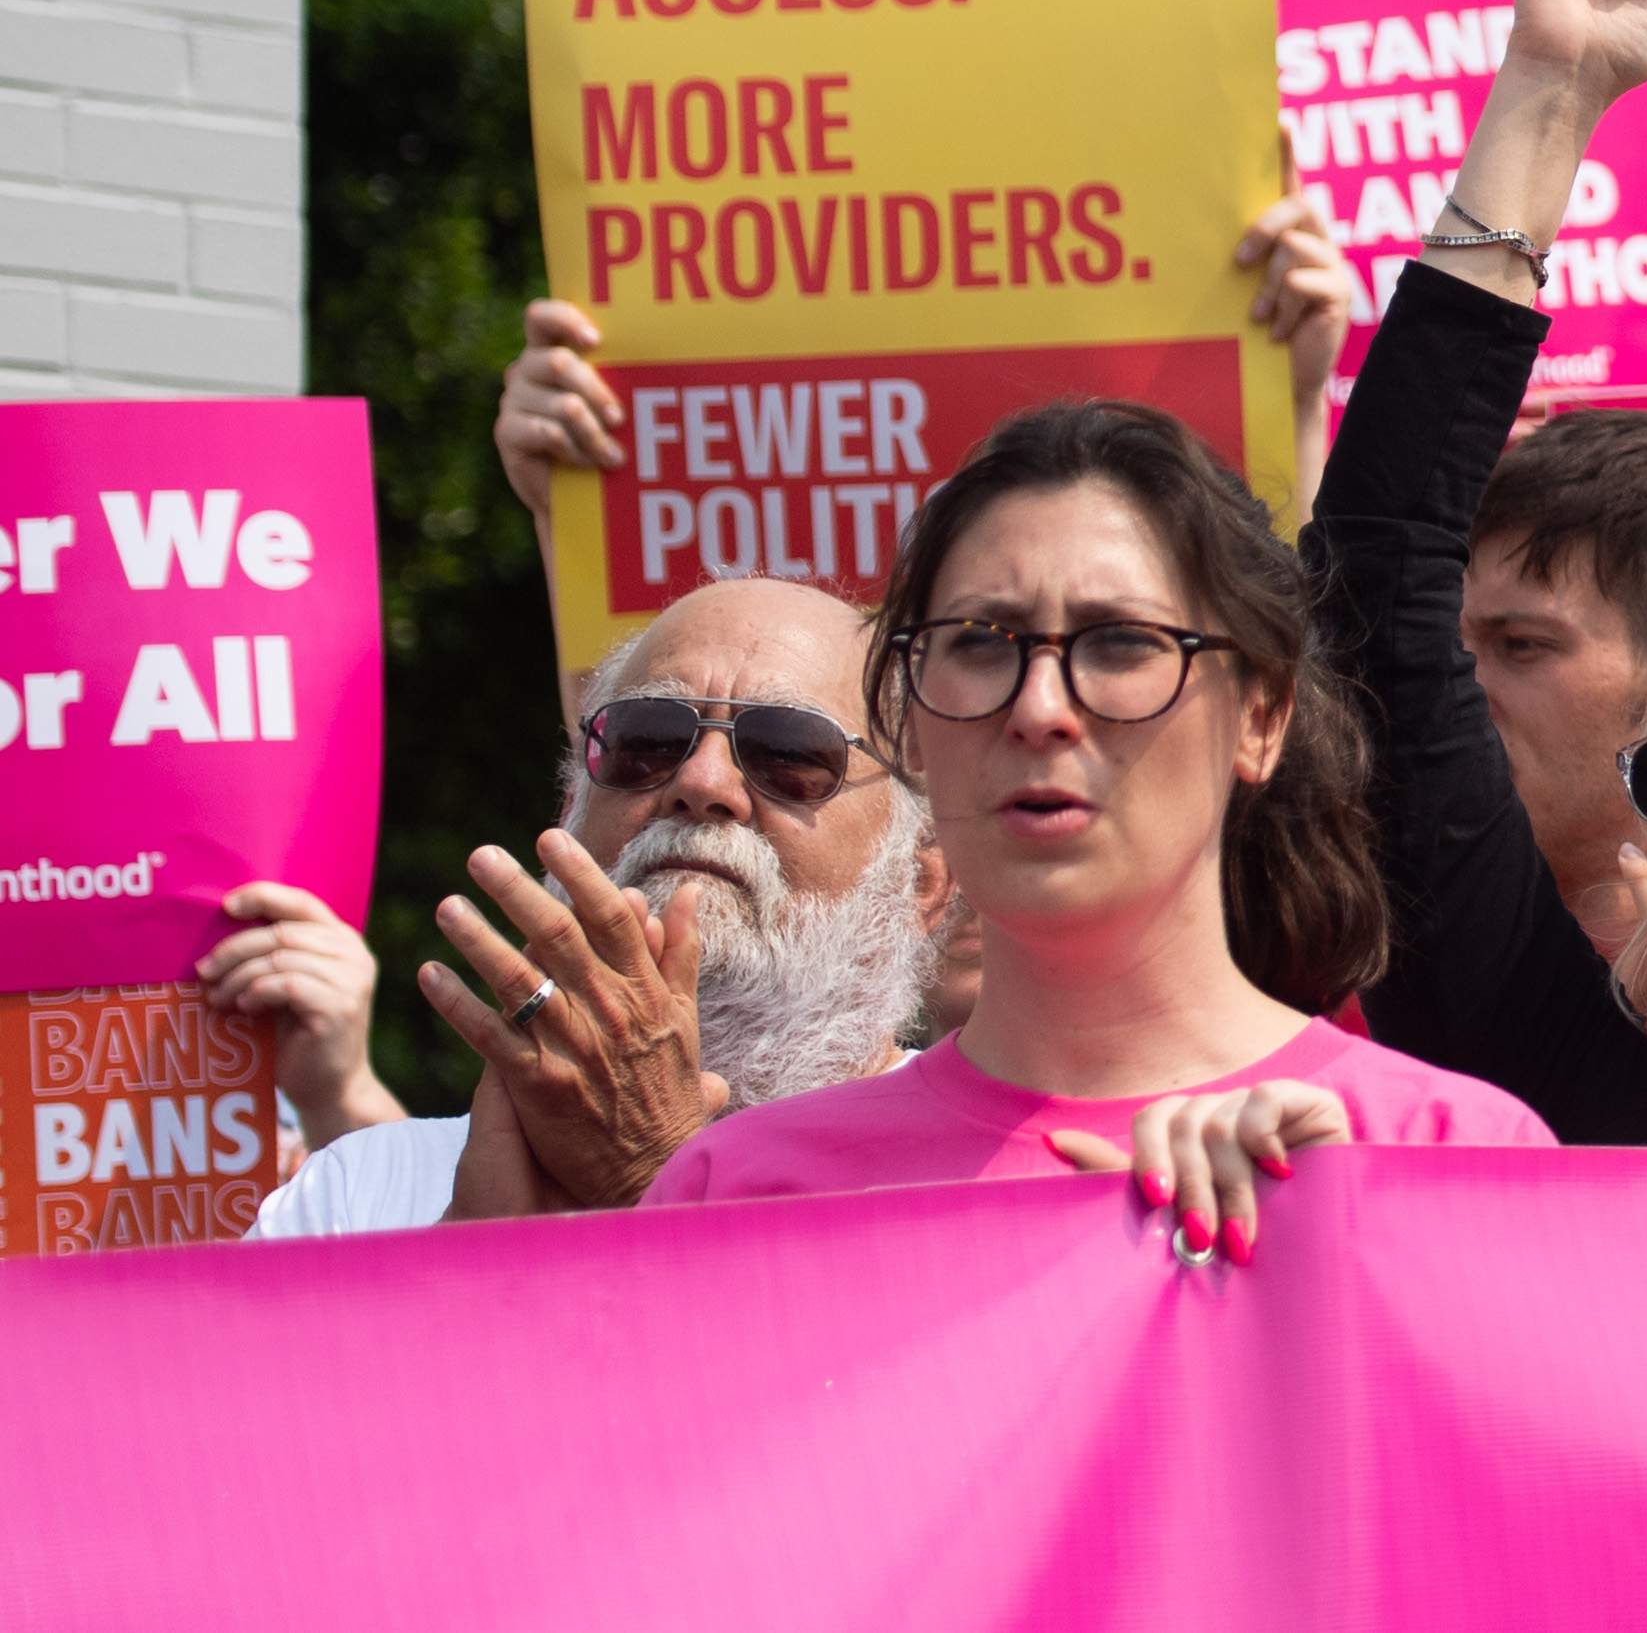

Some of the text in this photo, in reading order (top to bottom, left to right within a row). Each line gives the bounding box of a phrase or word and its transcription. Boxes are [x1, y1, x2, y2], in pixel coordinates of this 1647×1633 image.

[581, 72, 854, 184] MORE
[586, 181, 1154, 304] PROVIDERS.
[632, 378, 932, 481] FEWER
[99, 489, 313, 591] We
[109, 634, 296, 746] All
[29, 1003, 260, 1096] BANS
[34, 1091, 262, 1186] BANS
[36, 1180, 259, 1260] BANS
